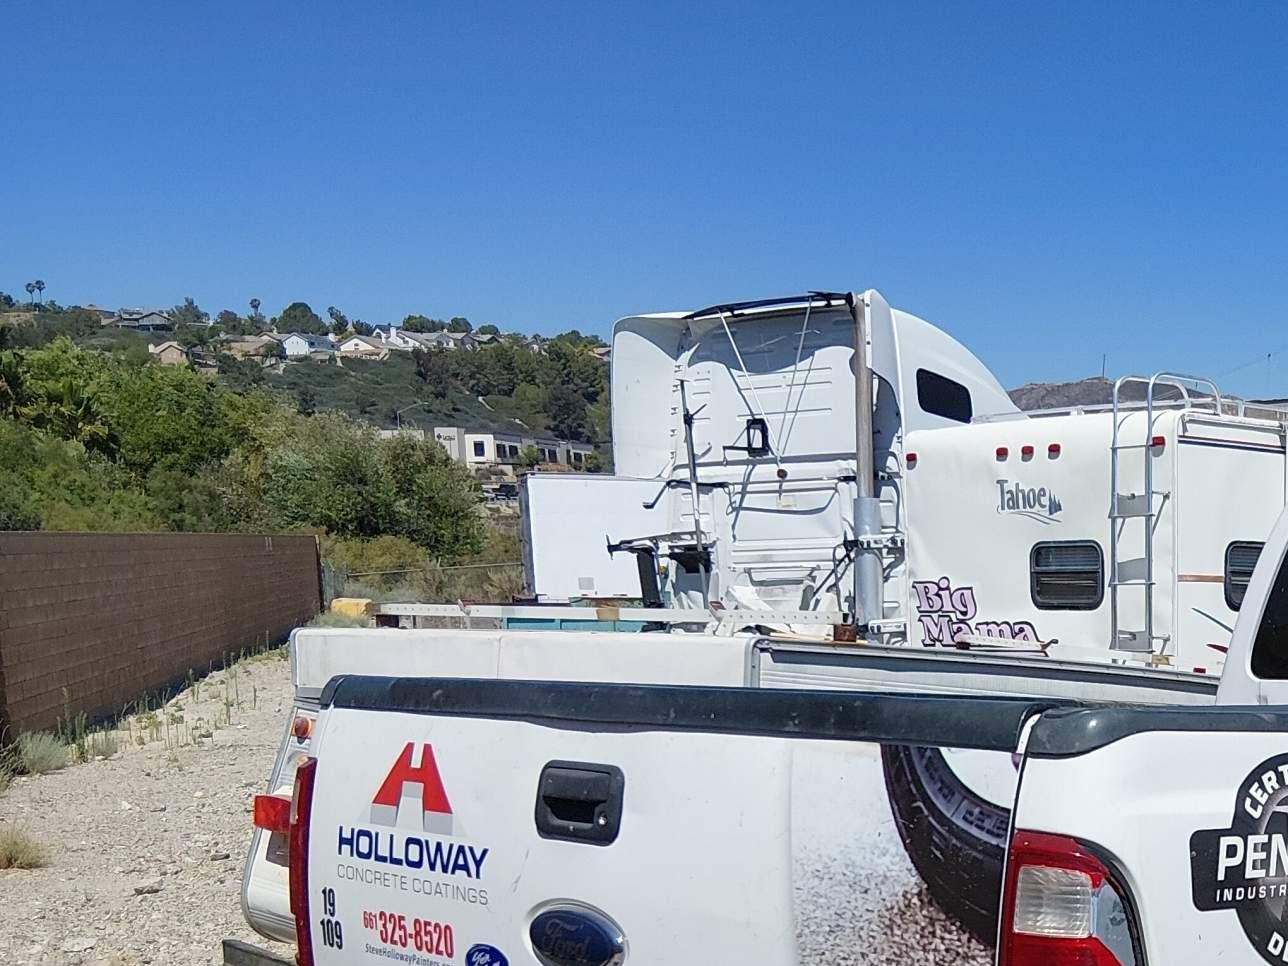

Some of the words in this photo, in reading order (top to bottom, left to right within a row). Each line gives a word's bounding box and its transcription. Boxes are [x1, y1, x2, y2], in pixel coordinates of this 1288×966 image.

[996, 479, 1047, 511] Tahoe
[912, 576, 978, 622] Big
[917, 614, 1047, 650] Mama
[338, 825, 489, 880] HOLLOWAY
[321, 886, 336, 918] 19
[337, 864, 409, 891] CONCRETE
[412, 878, 489, 906] COATINGS
[319, 918, 344, 950] 109
[363, 911, 378, 930] 661
[378, 911, 455, 958] 325-8520
[543, 918, 593, 962] Ford
